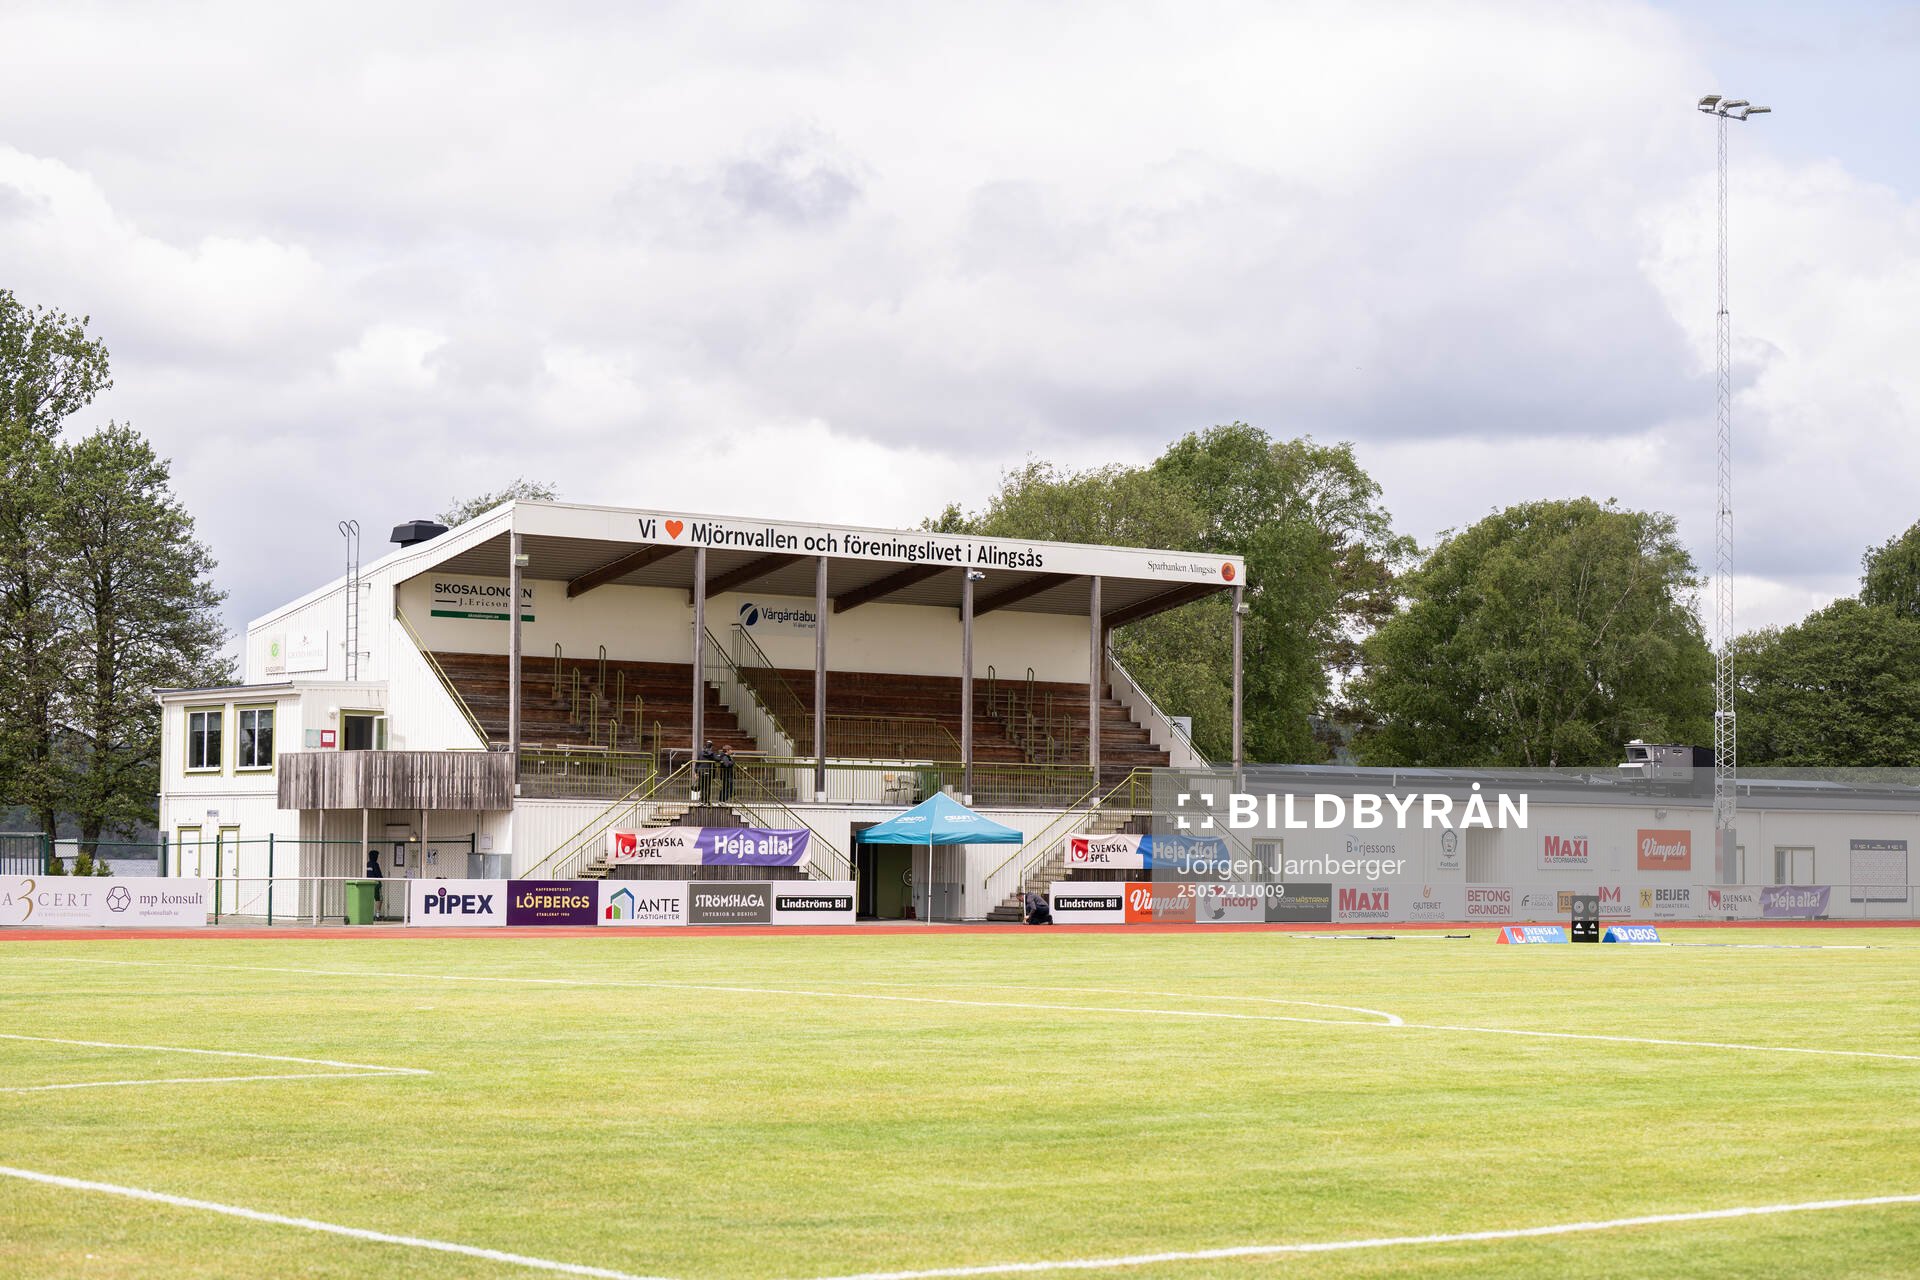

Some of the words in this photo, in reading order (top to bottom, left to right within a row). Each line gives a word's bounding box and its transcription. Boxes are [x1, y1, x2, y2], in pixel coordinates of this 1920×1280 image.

[638, 518, 656, 539] Vi
[691, 522, 798, 550] Mjörnvallen
[804, 533, 838, 553] och
[844, 534, 962, 562] föreningslivet
[967, 544, 972, 563] i
[977, 545, 1043, 568] Alingsås
[434, 582, 532, 599] SKOSALONN
[761, 607, 816, 623] Vårgårdabu
[638, 848, 662, 858] SPEL
[640, 837, 684, 848] SVENSKA
[714, 835, 754, 859] Heja
[758, 835, 793, 856] alla!
[1090, 843, 1128, 853] SVENSKA
[1153, 841, 1185, 864] Heja
[1190, 842, 1218, 863] dig!
[1642, 838, 1687, 862] Vimpeln
[1090, 854, 1111, 863] SPEL
[139, 895, 158, 906] mp
[161, 892, 203, 905] konsult
[516, 892, 590, 909] LÖFBERGS
[695, 893, 765, 908] STRÖMSHAGA
[1338, 888, 1389, 911] MAXI
[1467, 890, 1511, 902] BETONG
[1656, 889, 1690, 901] BEIJER
[1723, 894, 1753, 903] SVENSKA
[1797, 892, 1820, 909] alla!
[638, 898, 680, 912] ANTE
[781, 898, 832, 909] Lindströms
[835, 898, 847, 908] Bil
[1060, 898, 1105, 909] Lindströms
[1107, 898, 1117, 908] Bil
[1130, 888, 1192, 917] Vimpeln
[1222, 895, 1258, 910] incorp
[1623, 905, 1631, 914] AB
[1348, 911, 1389, 919] STORMARKNAD
[1467, 905, 1511, 915] GRUNDEN
[1525, 928, 1559, 936] SVENSKA
[1629, 928, 1657, 940] OBOS
